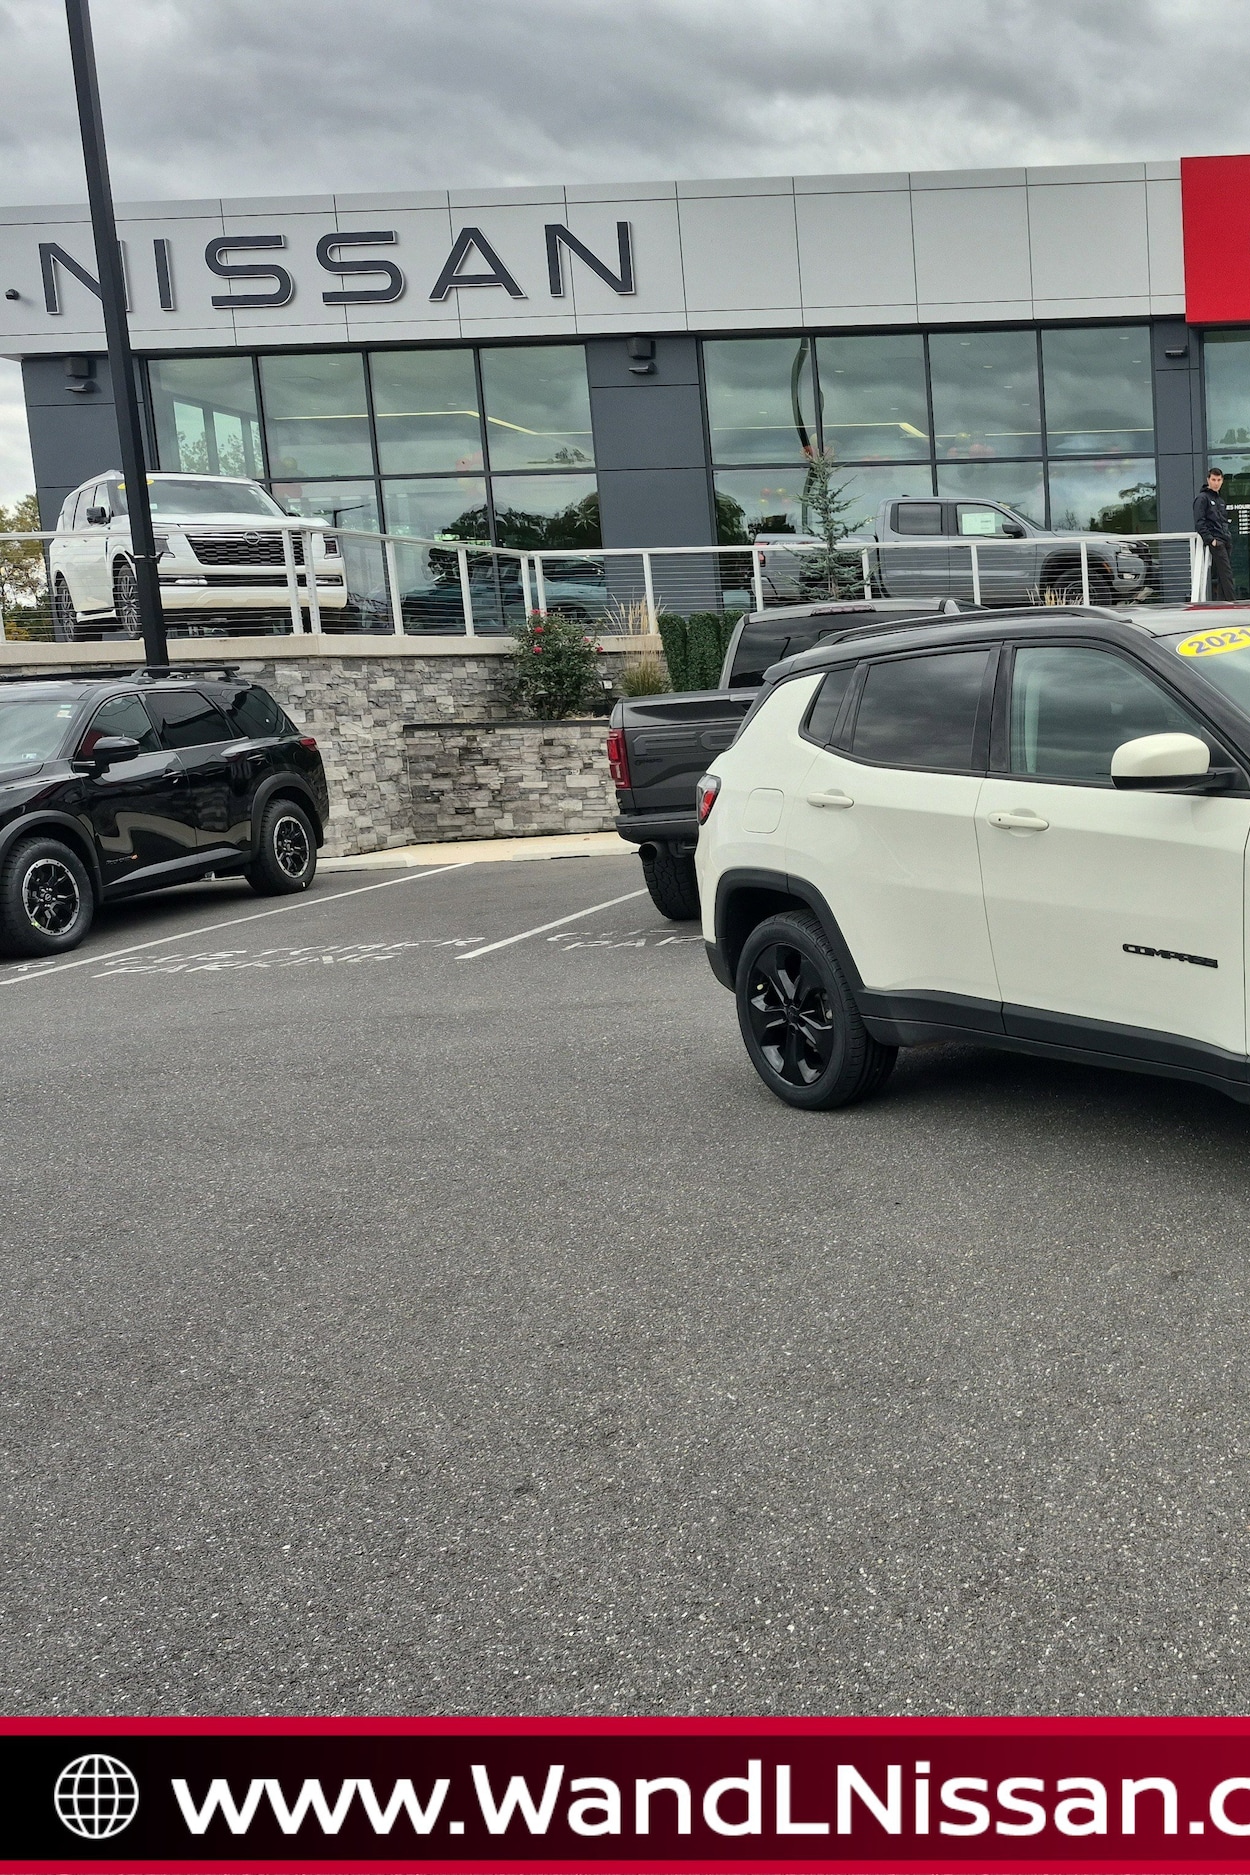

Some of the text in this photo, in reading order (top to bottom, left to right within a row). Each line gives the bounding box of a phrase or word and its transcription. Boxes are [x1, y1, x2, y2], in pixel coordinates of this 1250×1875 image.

[37, 219, 637, 316] NISSAN
[91, 952, 402, 978] PARKING
[1122, 943, 1219, 969] COMPASS
